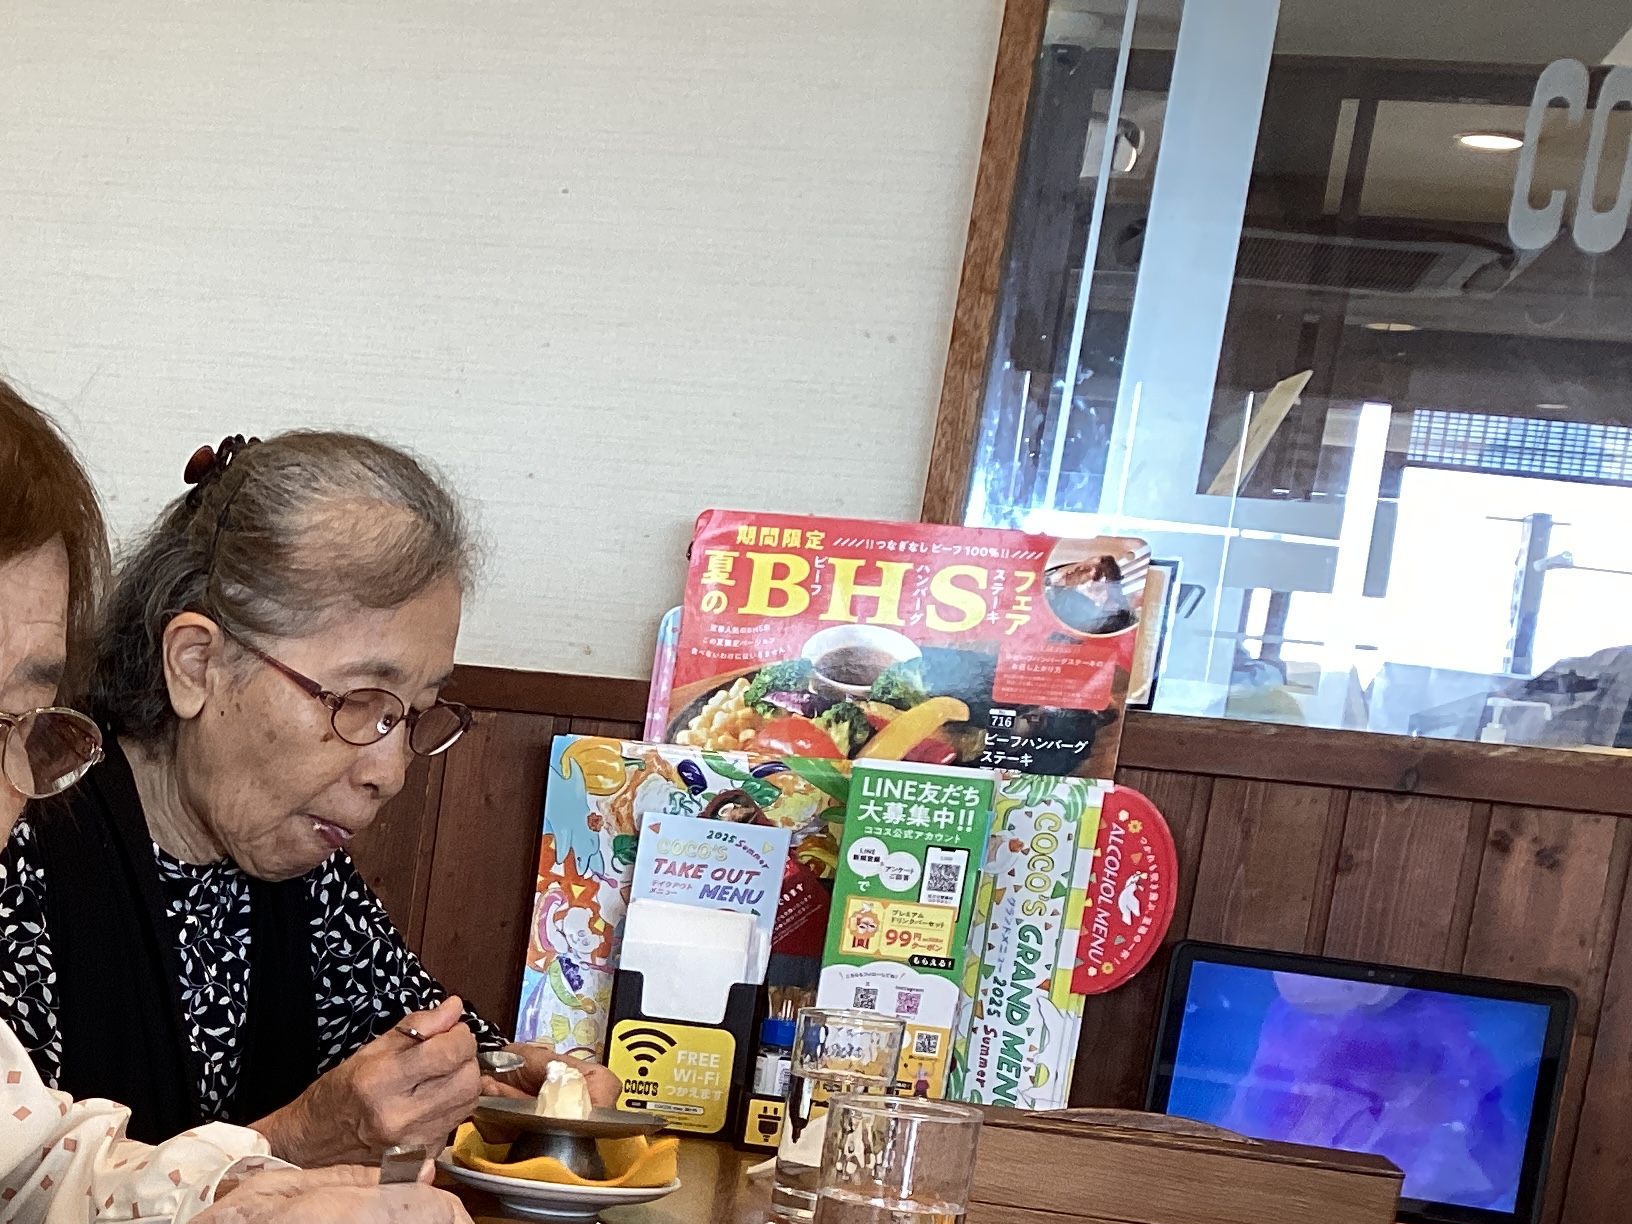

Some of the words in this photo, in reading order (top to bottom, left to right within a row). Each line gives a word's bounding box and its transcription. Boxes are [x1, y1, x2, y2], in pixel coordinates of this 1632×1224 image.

[736, 525, 826, 550] 期間限定
[701, 550, 740, 614] 夏の
[810, 556, 828, 596] ビーフ
[909, 564, 931, 626] ハンバーグ
[986, 569, 1006, 624] ステーキ
[1004, 570, 1036, 635] フェア
[991, 716, 1012, 728] 716
[984, 732, 1088, 753] ビーフハンバーグ
[980, 751, 1034, 767] ステーキ
[861, 776, 980, 807] LINE友だち
[857, 800, 975, 832] 大募集中!!
[864, 826, 961, 844] ココス公式アカウント
[657, 837, 728, 861] COCO'S
[706, 830, 737, 843] 2025
[735, 839, 769, 869] Summer
[654, 858, 708, 880] TAKE
[710, 867, 761, 885] OUT
[885, 865, 915, 875] アンケート
[1021, 812, 1062, 917] COCO'S
[1097, 822, 1125, 905] ALCOHOL
[699, 884, 765, 905] MENU
[857, 880, 871, 892] で
[891, 917, 946, 929] ドリンクバーセット
[892, 909, 925, 919] プレミアム
[1087, 907, 1111, 965] MENU
[913, 957, 952, 968] もらえる!
[1005, 924, 1043, 1026] GRAND
[986, 975, 1007, 1018] 2025
[676, 1050, 721, 1068] FREE
[976, 1025, 998, 1088] Summer
[624, 1079, 659, 1096] COCO'S
[665, 1085, 723, 1101] つかえます
